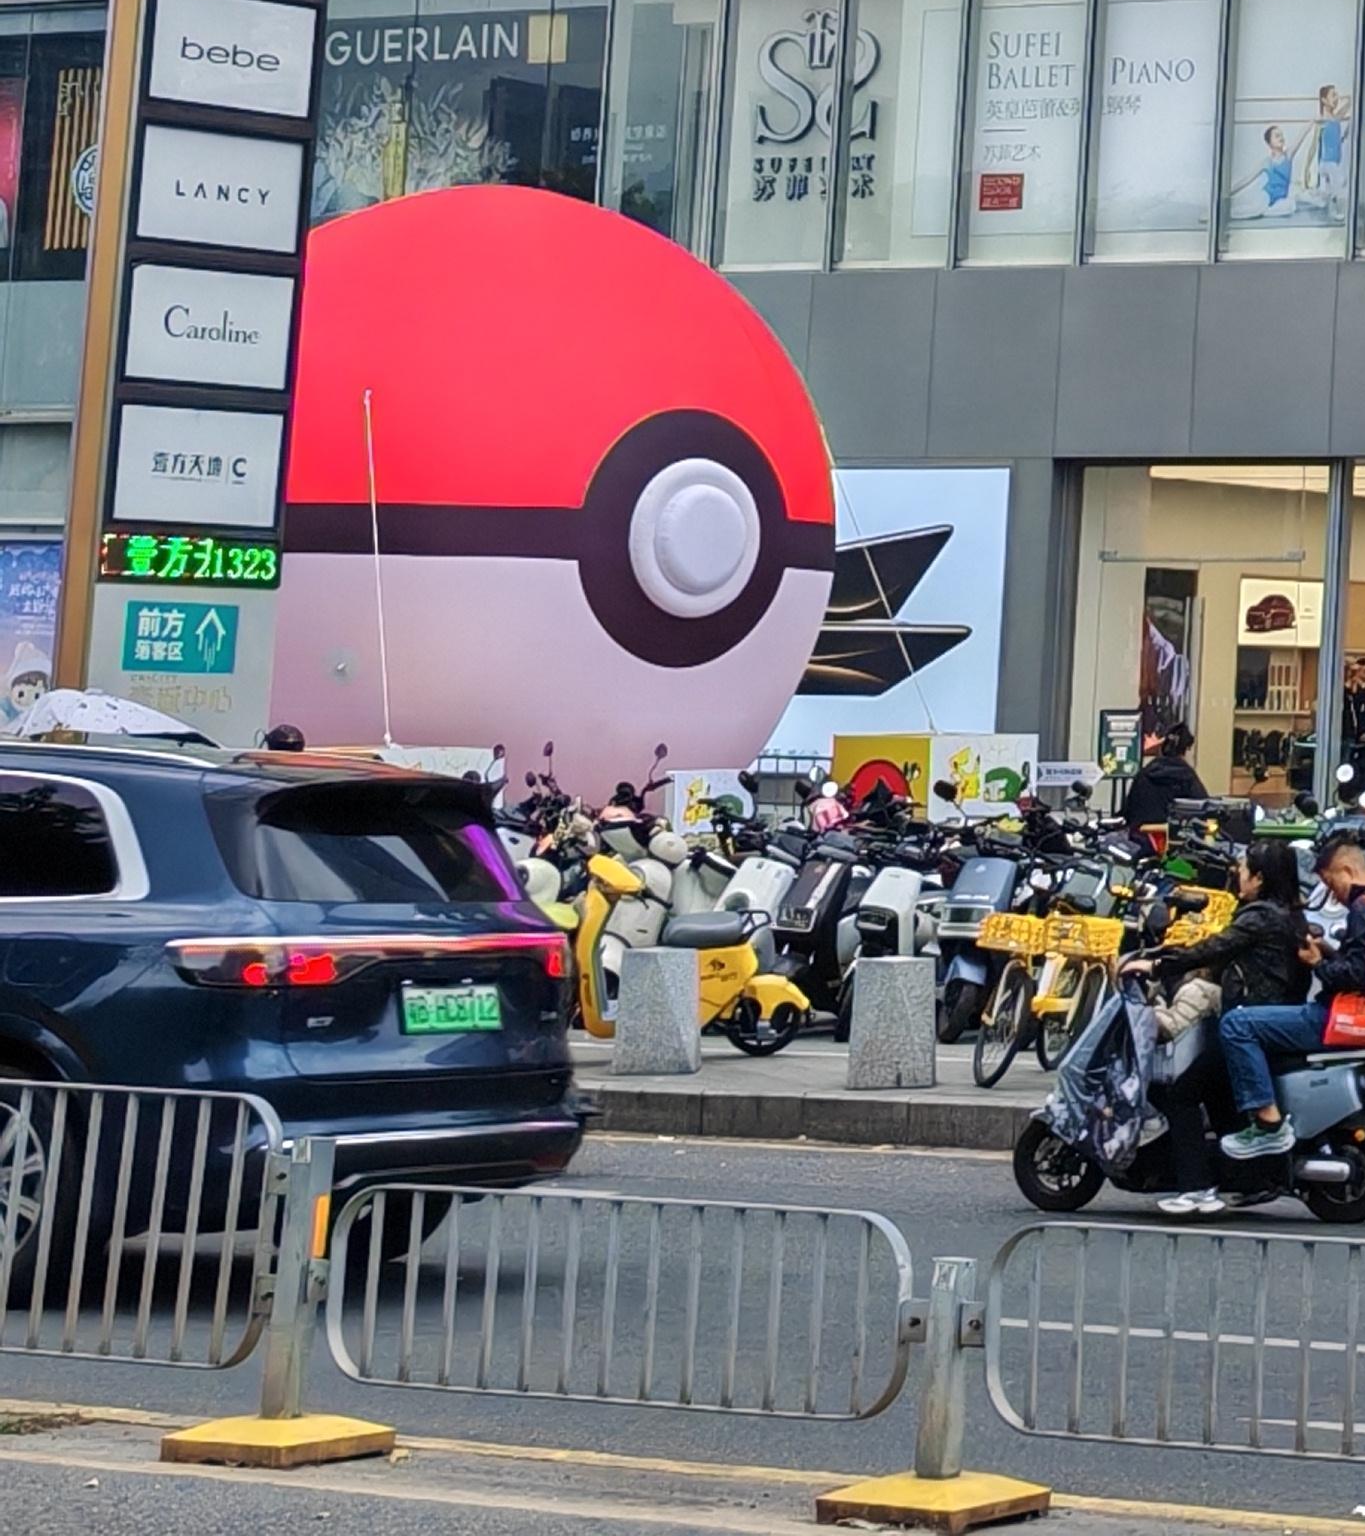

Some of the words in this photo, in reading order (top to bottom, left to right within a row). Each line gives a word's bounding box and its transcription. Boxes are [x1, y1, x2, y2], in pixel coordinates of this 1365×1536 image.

[180, 36, 281, 73] bebe
[325, 20, 520, 66] GUERLAIN
[987, 30, 1061, 60] SUFEI
[986, 62, 1077, 92] BALLET
[1110, 56, 1196, 87] PIANO
[174, 180, 271, 206] LANCY
[163, 305, 260, 346] Caroline
[138, 607, 186, 638] 前方
